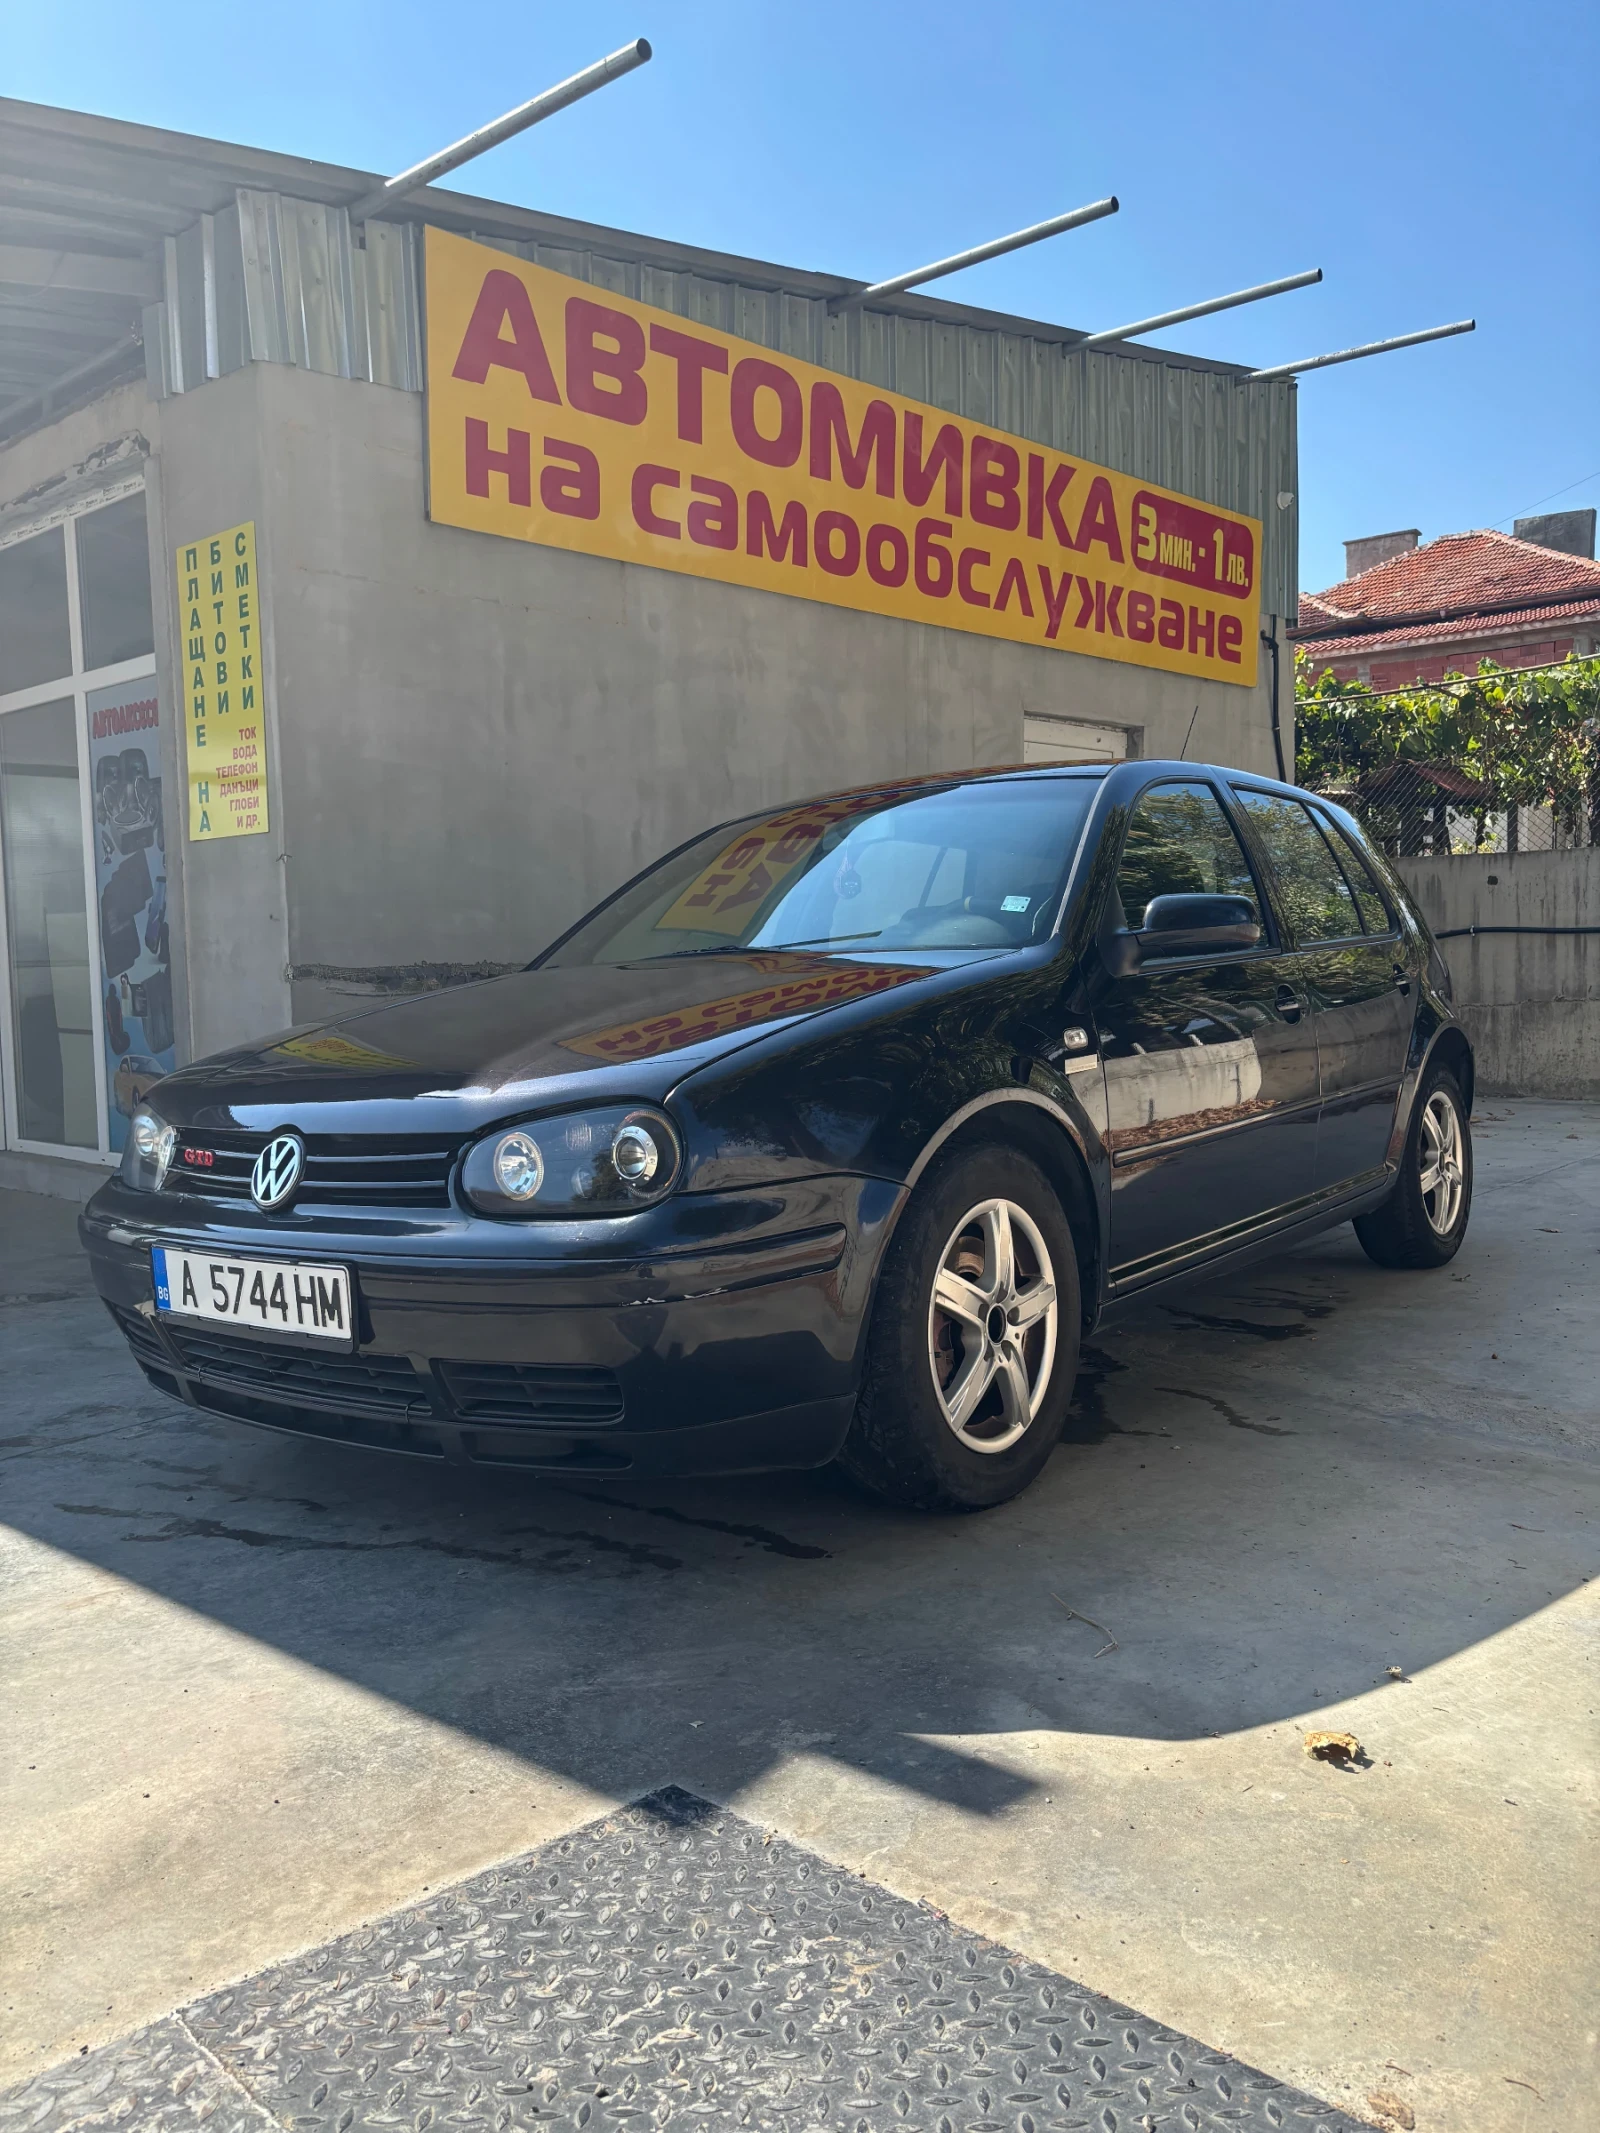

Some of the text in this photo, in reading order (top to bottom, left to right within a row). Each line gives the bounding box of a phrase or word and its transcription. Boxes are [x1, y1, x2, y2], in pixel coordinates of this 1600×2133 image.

[451, 268, 1125, 564] АВТОМИВКА
[631, 462, 1243, 665] самообслужване
[1212, 528, 1224, 581] 1
[210, 540, 230, 715] БИТОВИ
[234, 531, 255, 711] СМЕТКИ
[185, 547, 207, 748] ПЛАЩАНЕ
[238, 726, 257, 741] ТОК
[232, 744, 258, 760] ВОДА
[216, 762, 258, 780] ТЕЛЕФОН
[219, 778, 259, 798] ДАНЪЦИ
[229, 796, 260, 812] ГЛОБИ
[236, 814, 261, 830] И ДР.
[184, 1148, 214, 1167] GTD
[157, 1285, 169, 1301] BG
